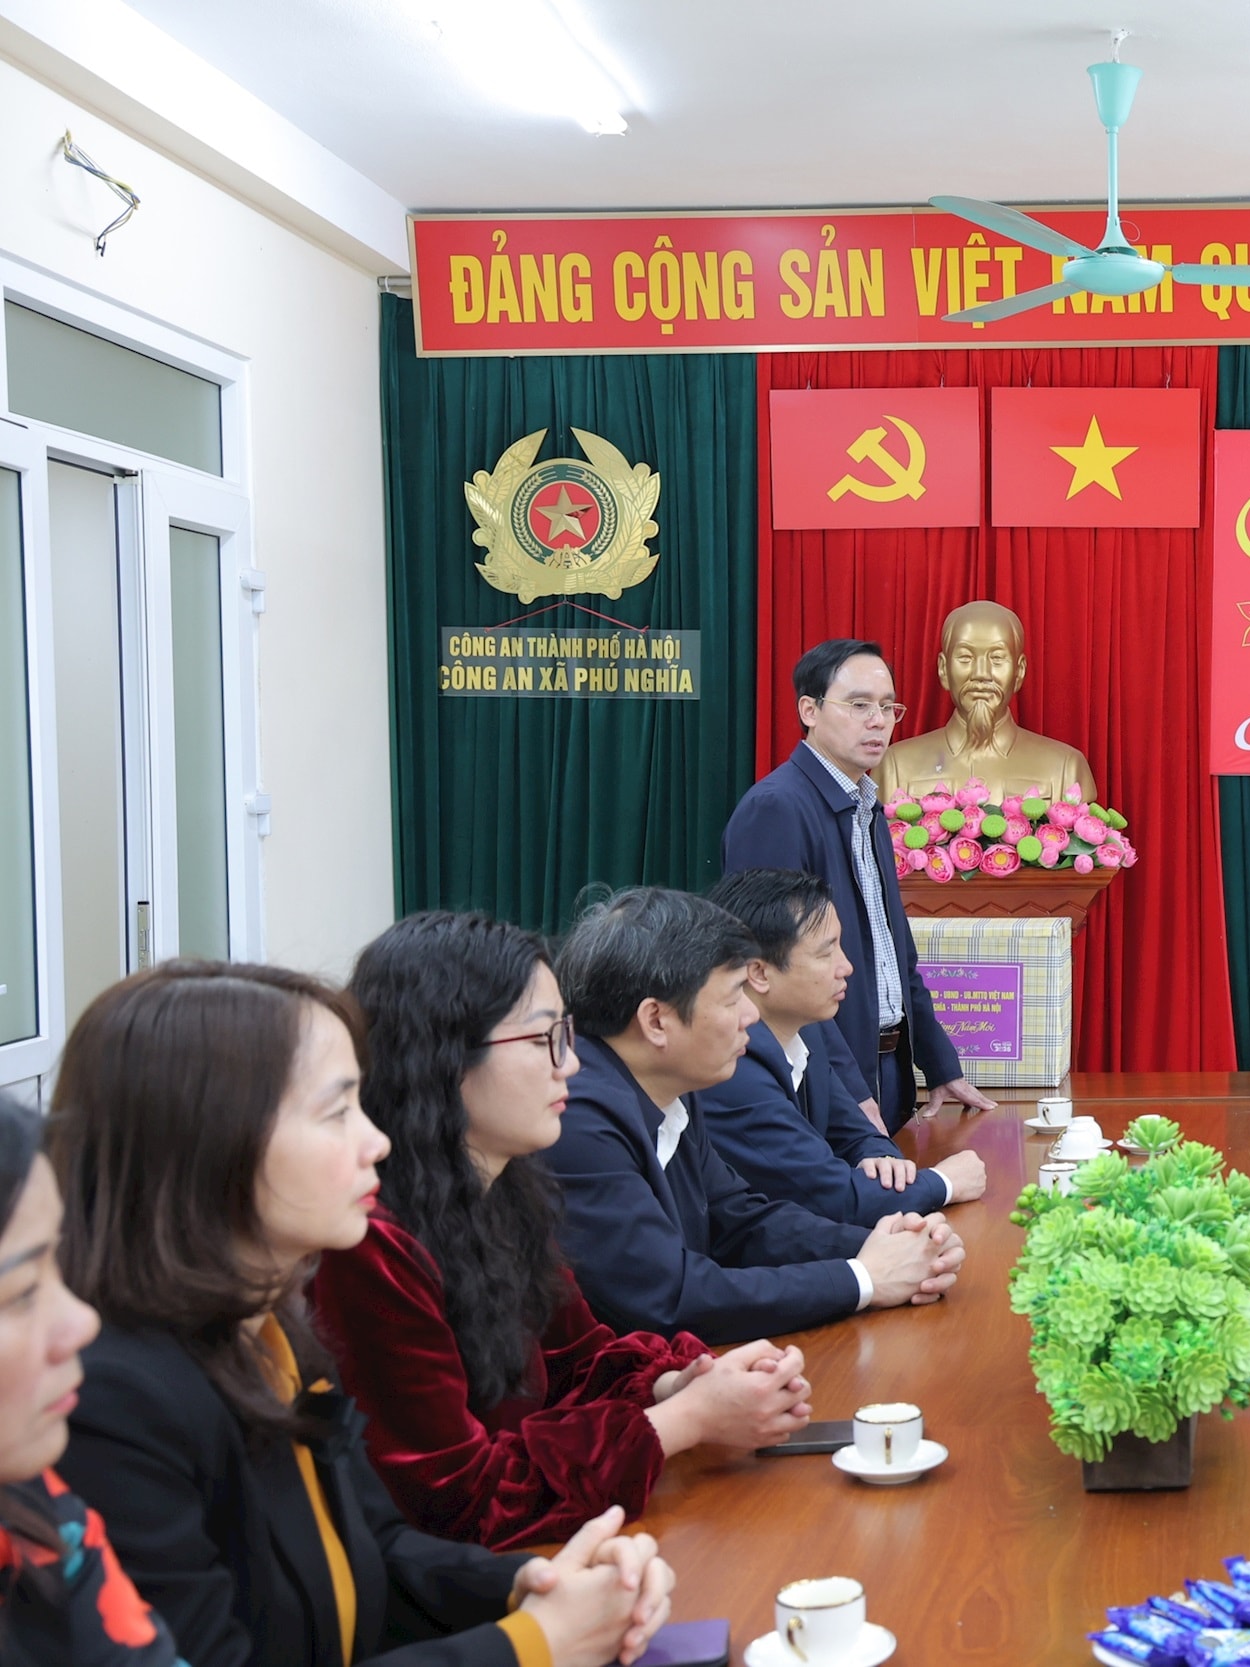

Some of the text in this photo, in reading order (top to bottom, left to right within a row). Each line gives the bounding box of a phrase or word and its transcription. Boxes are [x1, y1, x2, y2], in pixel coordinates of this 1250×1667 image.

[449, 229, 593, 325] ĐẢNG
[613, 235, 755, 335] CỘNG
[778, 224, 885, 319] SẢN
[910, 232, 1024, 329] VIỆT
[450, 632, 681, 664] CÔNG AN THÀNH PHỐ HÀ NỘI
[440, 660, 694, 693] CÔNG AN XÃ PHÚ NGHĨA
[951, 1001, 969, 1012] THÀNH
[988, 990, 1001, 1001] VIỆT
[1001, 991, 1015, 1000] NAM
